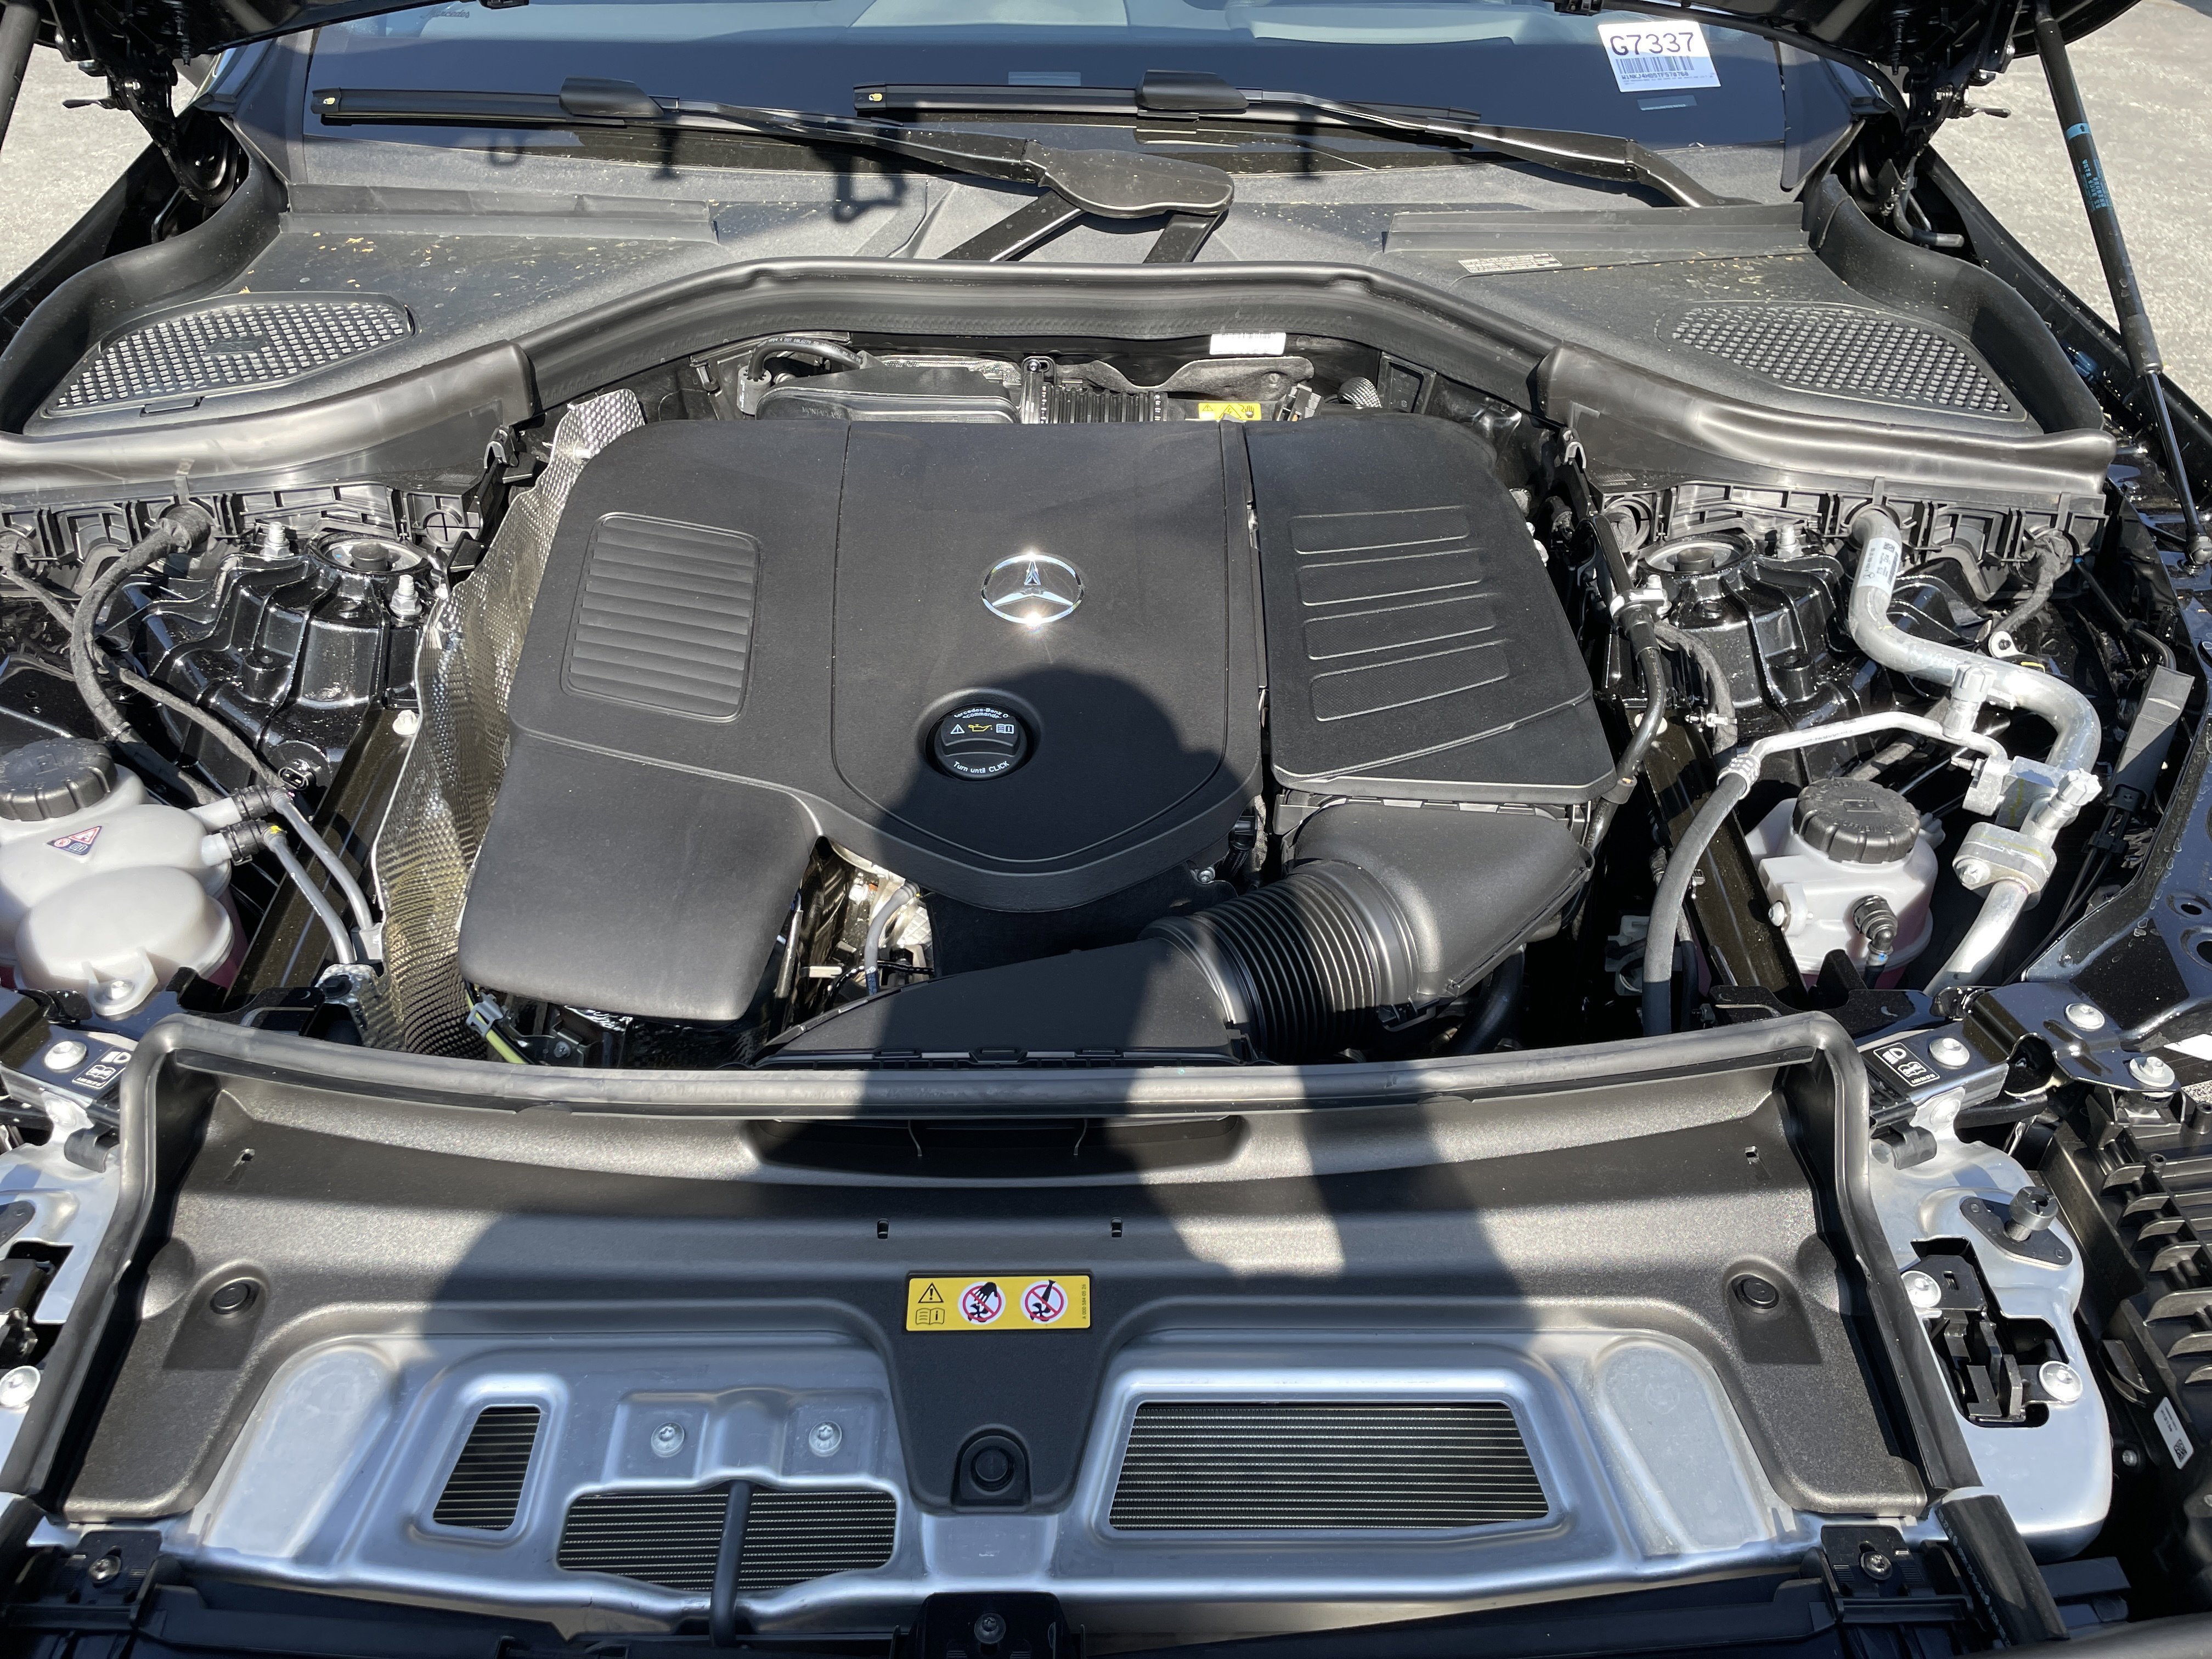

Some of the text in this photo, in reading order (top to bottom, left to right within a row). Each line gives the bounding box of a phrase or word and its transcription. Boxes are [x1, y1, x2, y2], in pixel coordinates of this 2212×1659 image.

[1610, 32, 1694, 56] G7337
[953, 761, 968, 772] Turn
[988, 760, 1010, 772] CLICK
